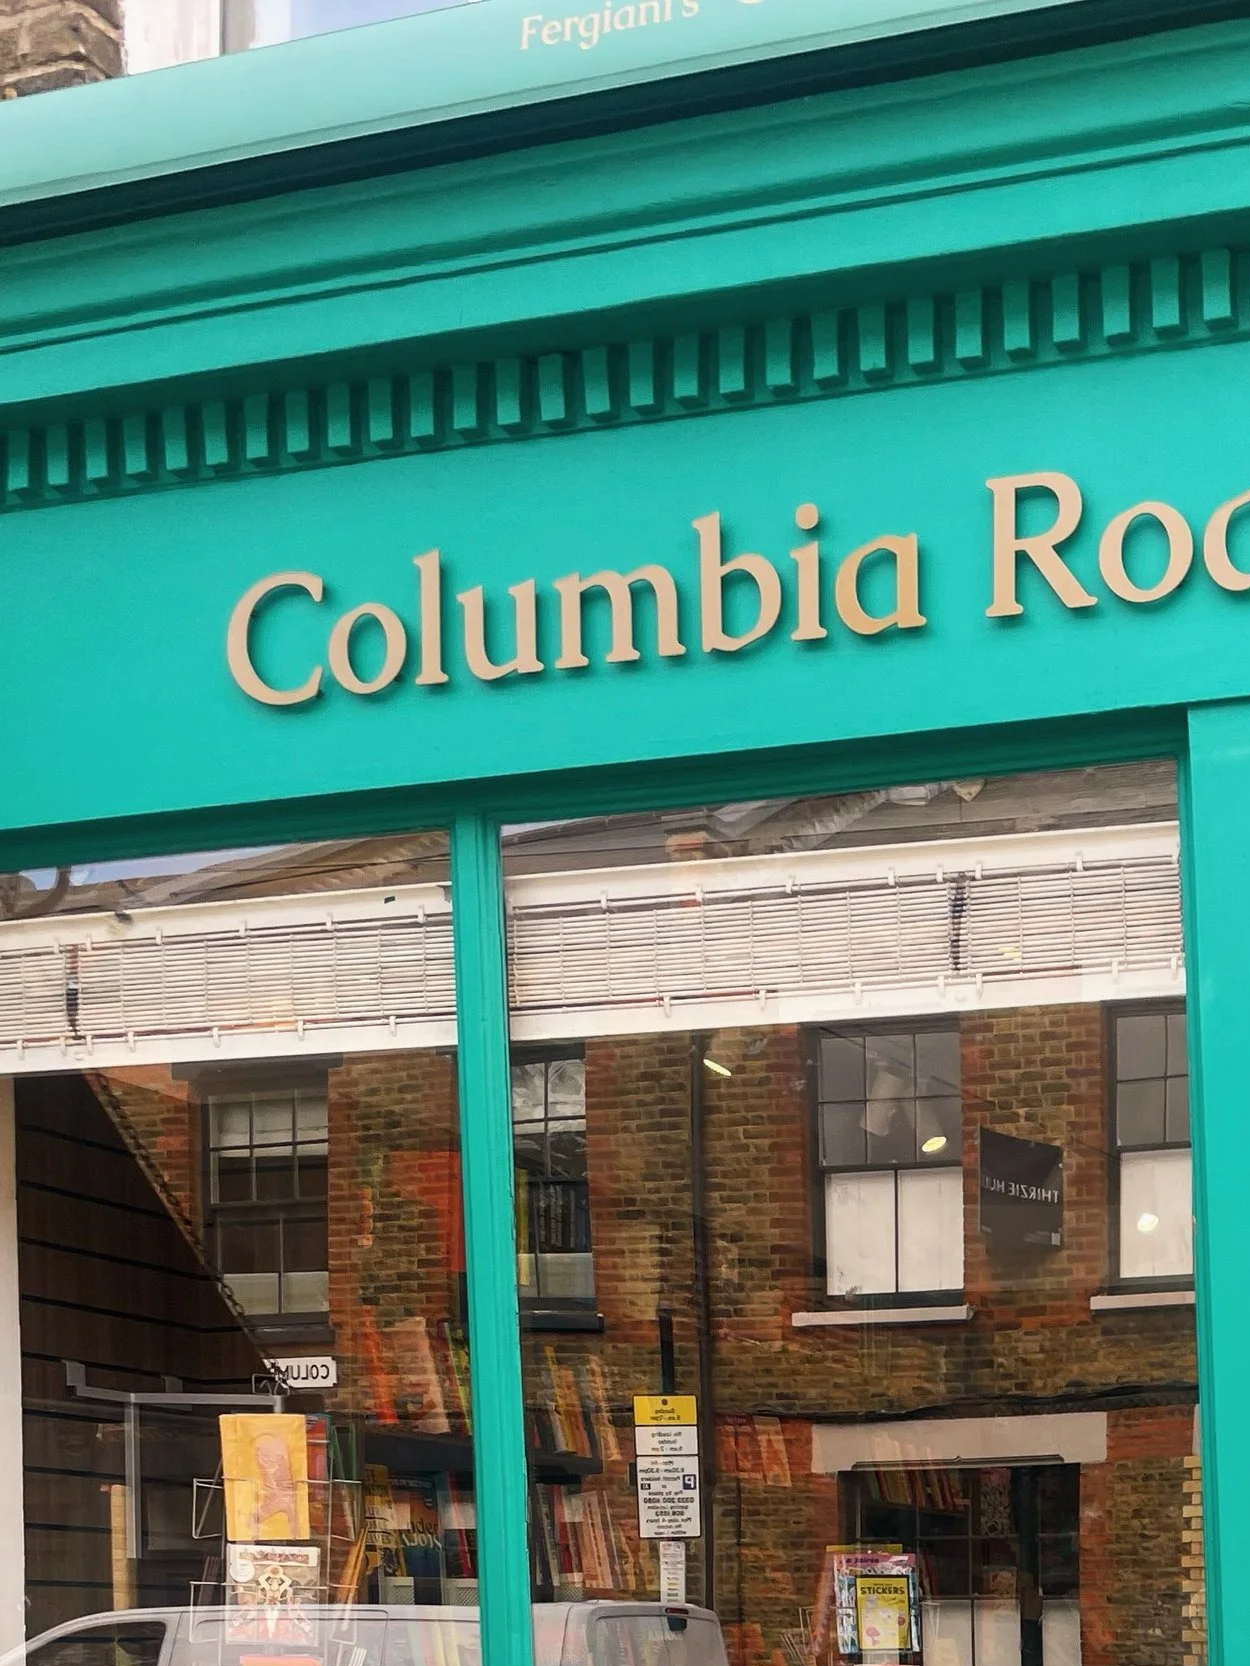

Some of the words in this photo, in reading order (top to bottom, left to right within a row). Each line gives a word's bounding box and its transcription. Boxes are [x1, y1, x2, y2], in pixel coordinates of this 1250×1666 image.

[520, 0, 700, 50] Fergianis
[223, 502, 931, 710] Columbia
[860, 1586, 905, 1595] STICKERS
